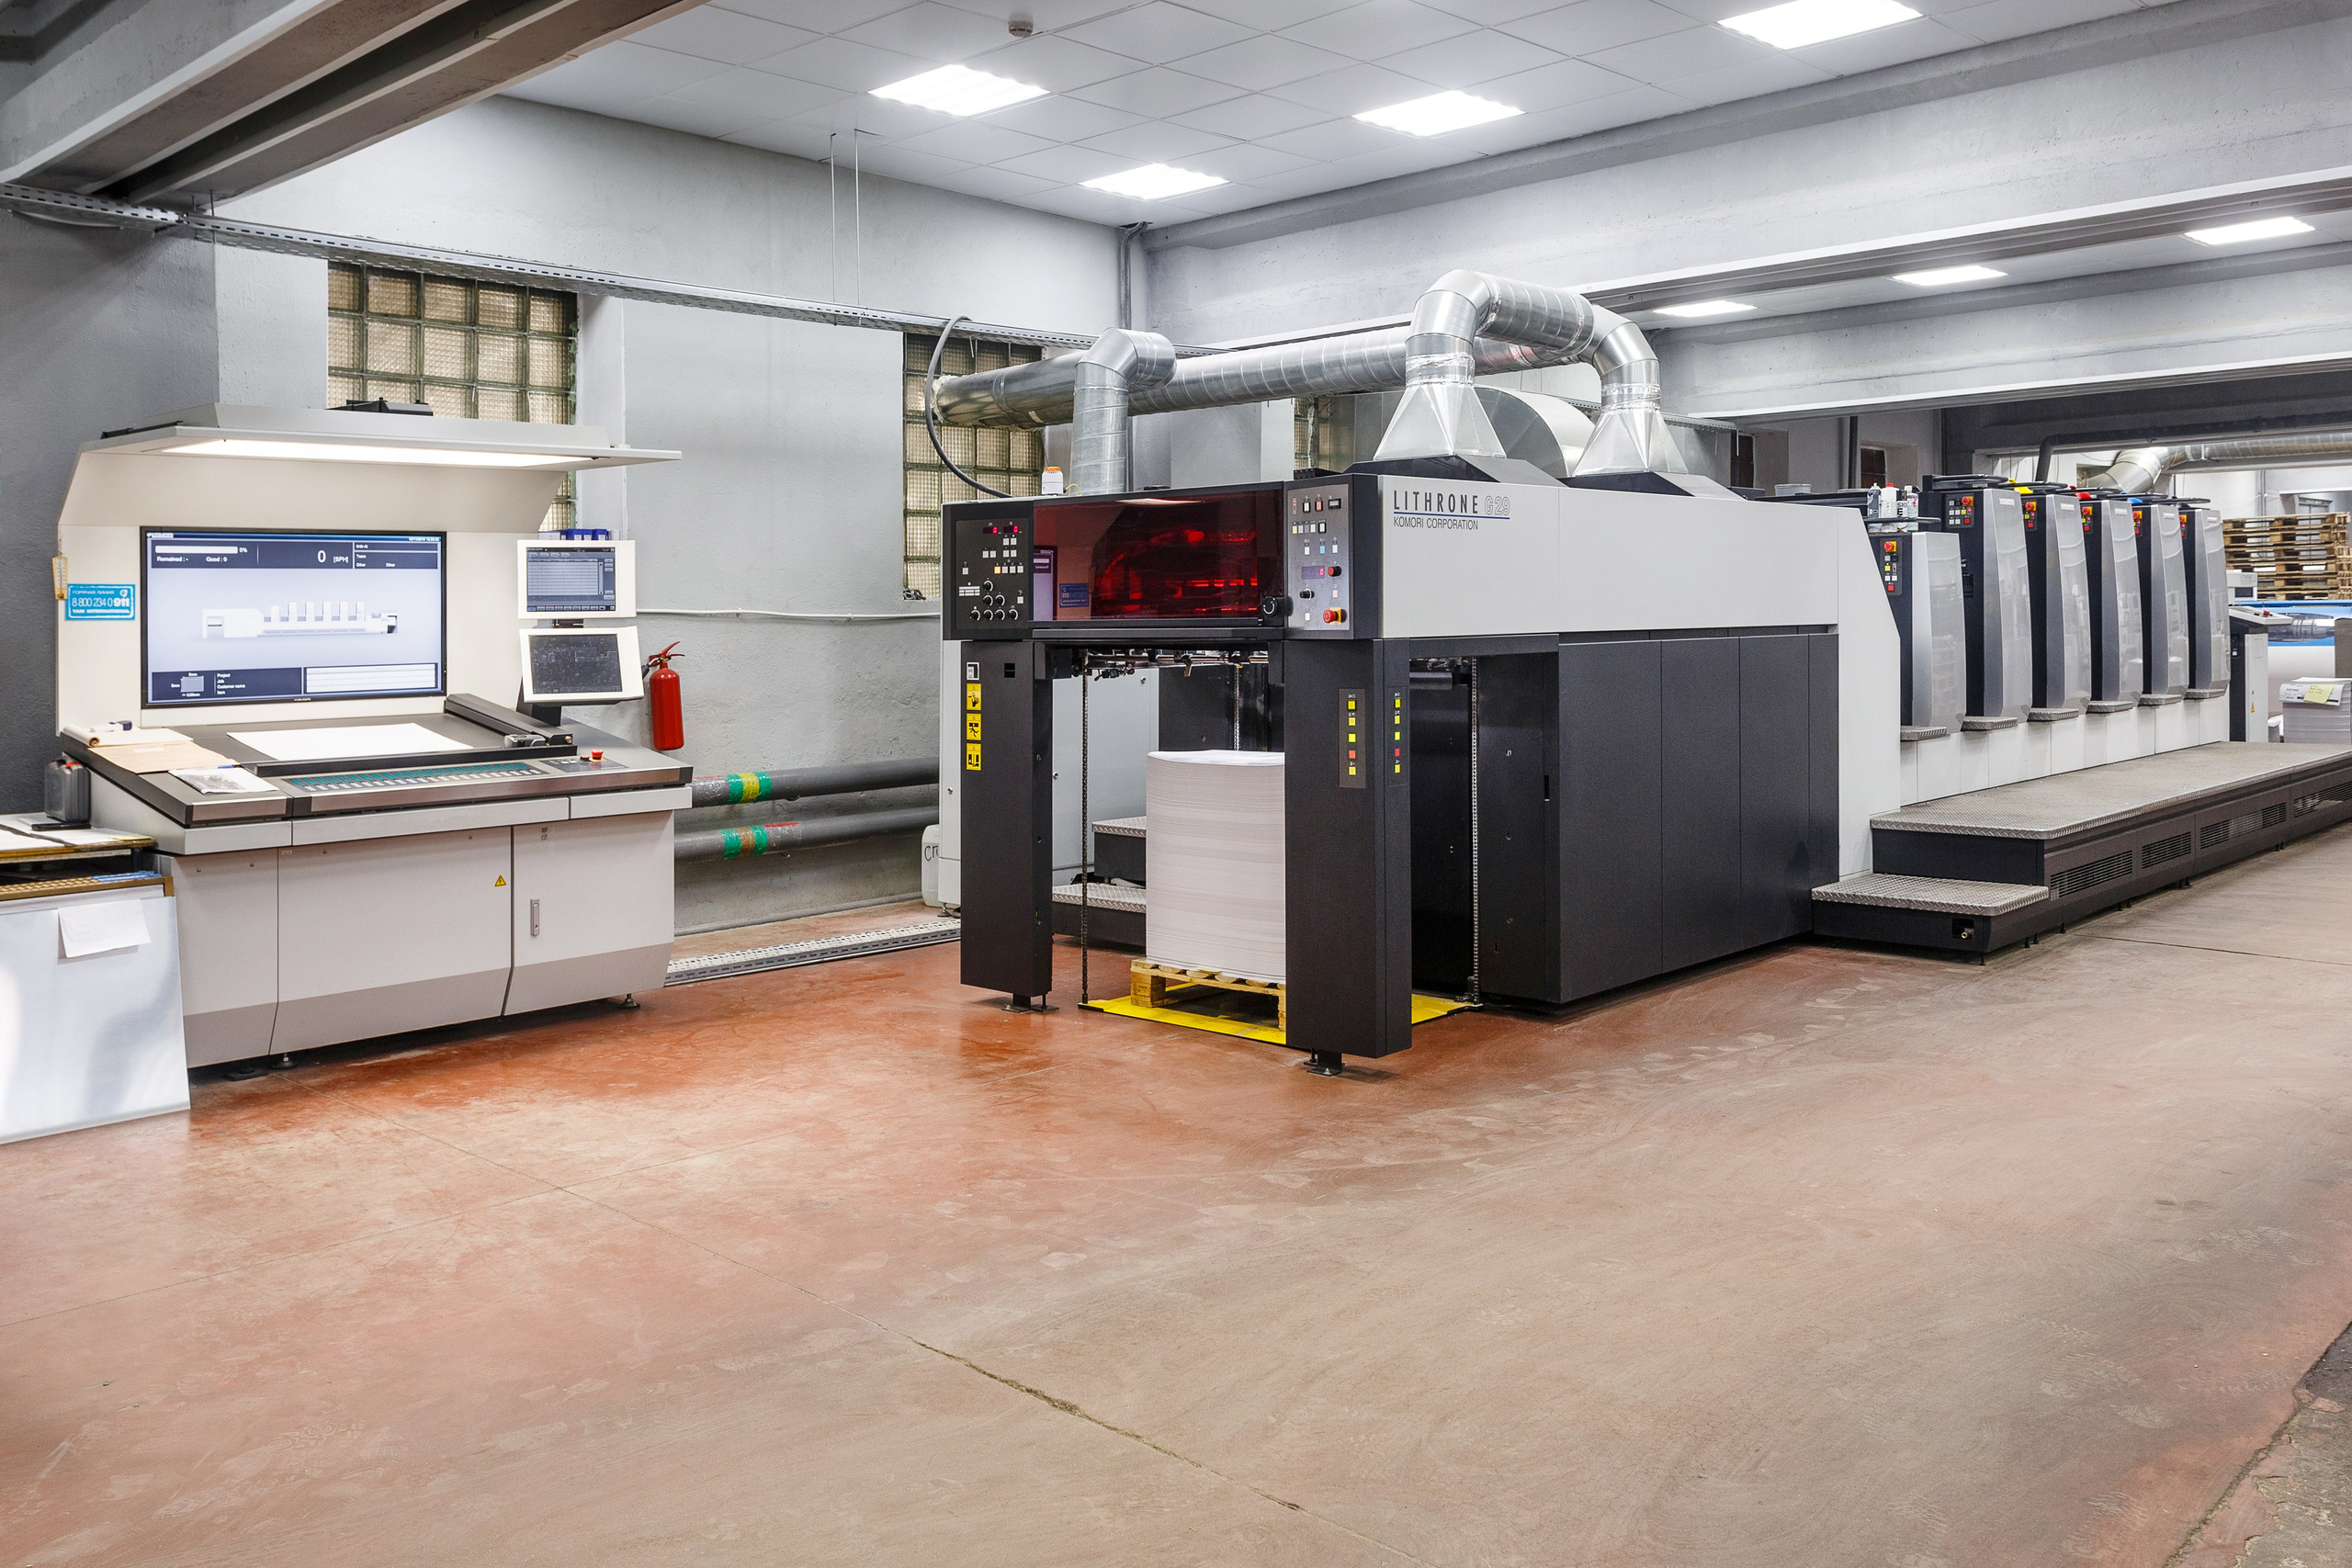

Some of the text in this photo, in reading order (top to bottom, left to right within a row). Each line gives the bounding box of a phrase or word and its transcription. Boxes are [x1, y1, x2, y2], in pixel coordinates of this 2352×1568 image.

[1394, 490, 1510, 516] LITHRONE G29
[1394, 516, 1478, 530] KOMORI CORPORATION
[317, 549, 326, 563] 0
[78, 597, 92, 607] 800
